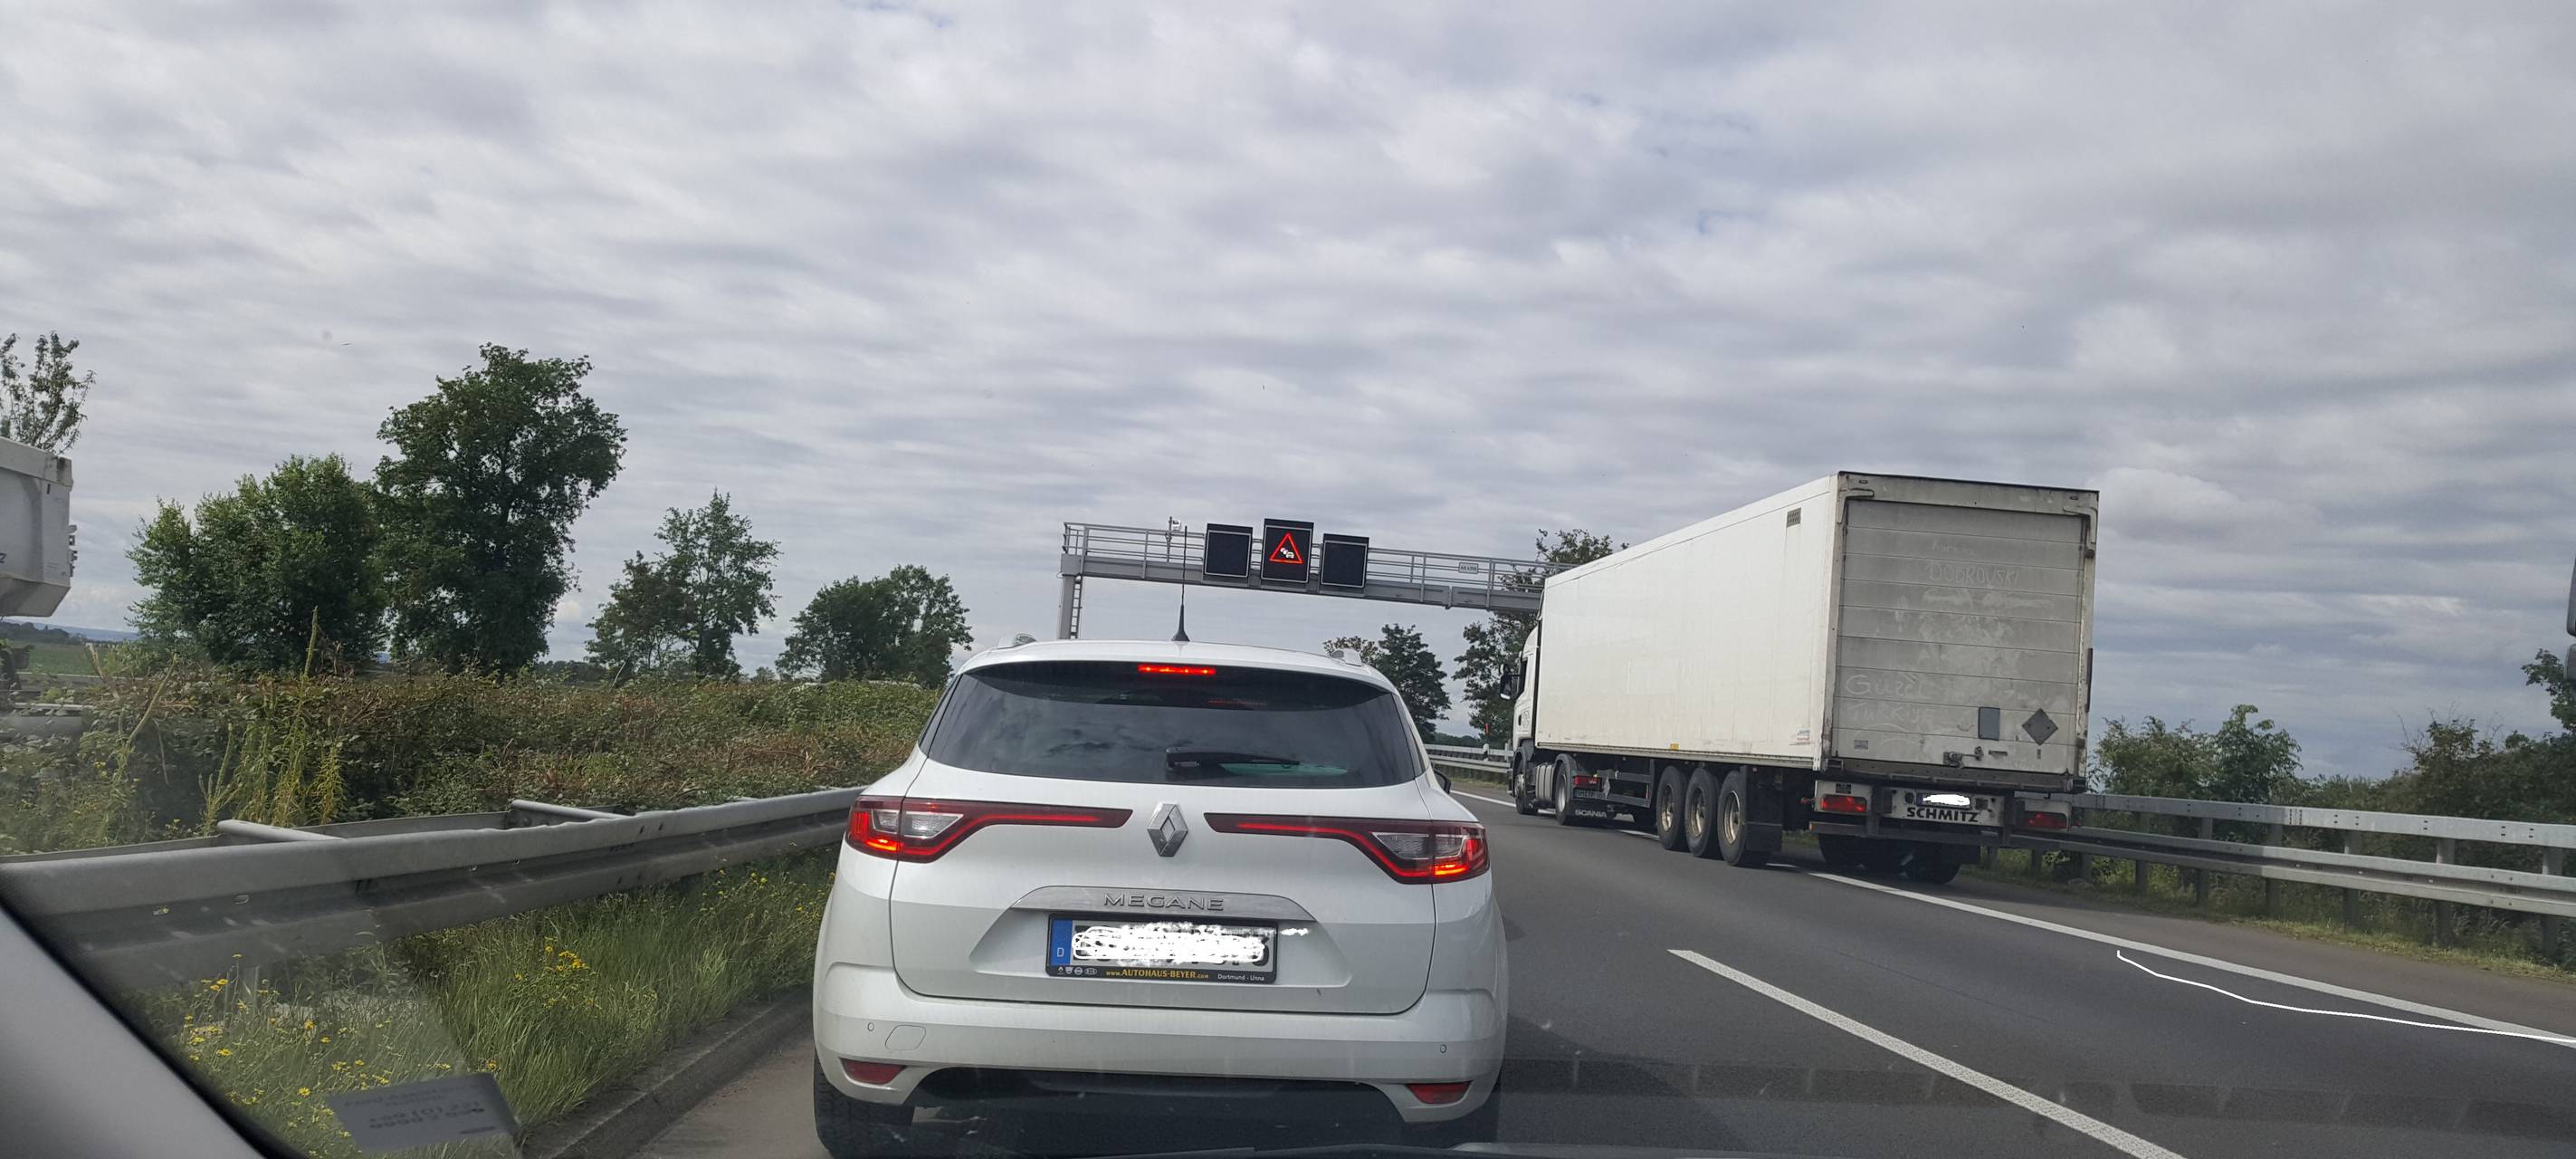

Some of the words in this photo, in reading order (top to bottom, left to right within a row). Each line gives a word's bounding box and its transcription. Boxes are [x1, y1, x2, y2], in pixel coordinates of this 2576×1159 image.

[1575, 809, 1607, 818] SCANIA
[1907, 807, 1979, 822] SCHMITZ
[1103, 893, 1224, 911] MEGANE
[1056, 947, 1064, 958] D
[1217, 973, 1245, 982] Dortmund
